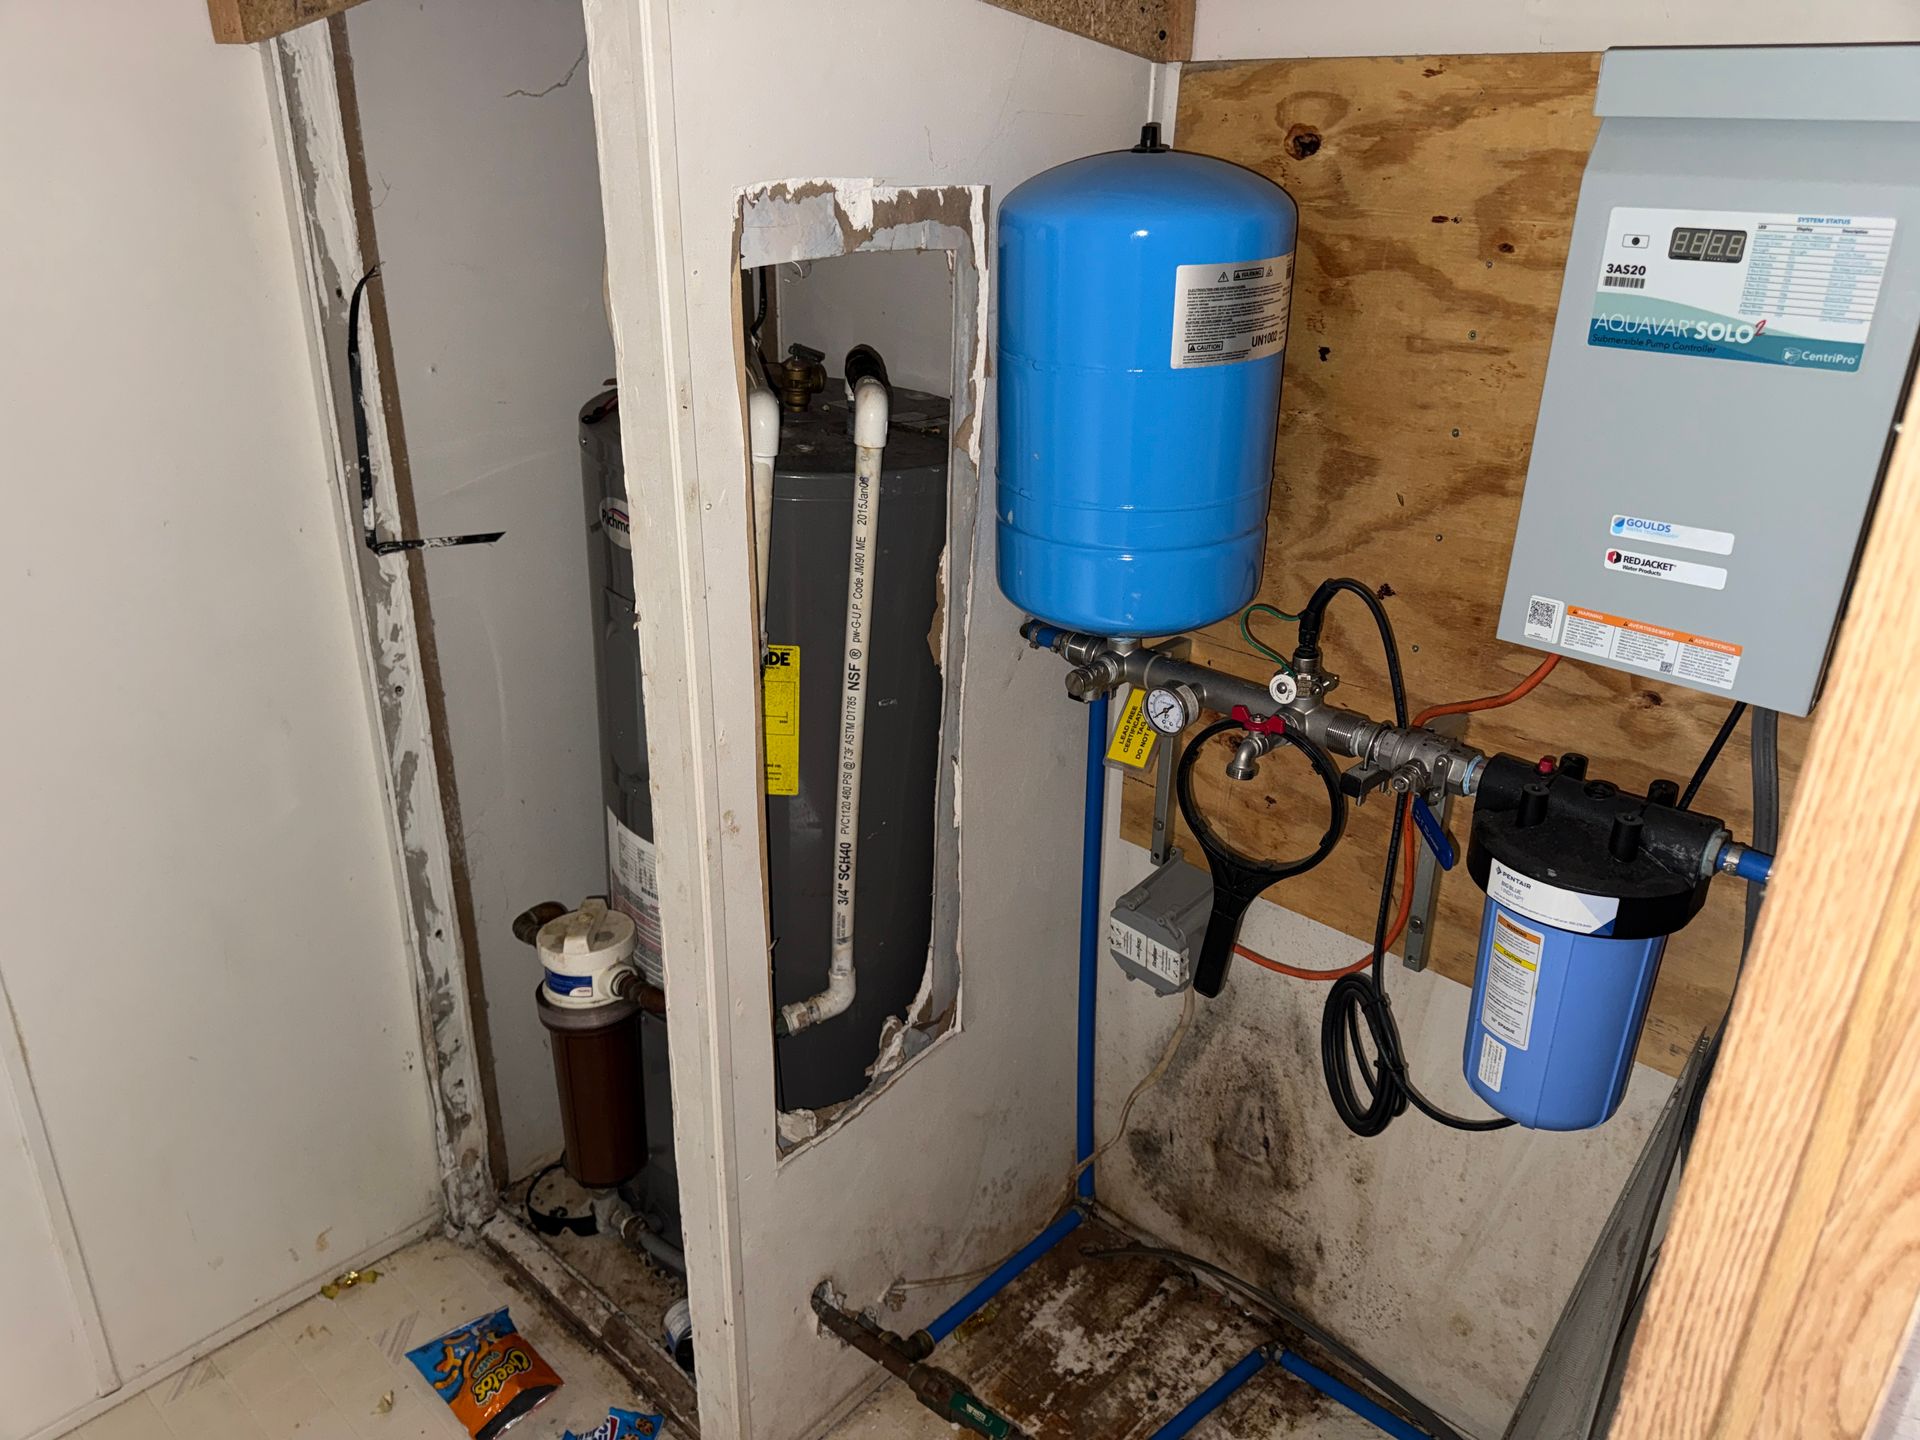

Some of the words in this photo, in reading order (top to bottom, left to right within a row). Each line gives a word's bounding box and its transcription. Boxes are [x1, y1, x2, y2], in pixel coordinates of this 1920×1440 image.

[1797, 216, 1824, 224] SYSTEM
[1825, 217, 1851, 225] STATUS
[1606, 263, 1646, 276] 3AS20
[1594, 312, 1688, 338] AQUAVAR
[1251, 331, 1278, 348] UN1002
[1592, 333, 1644, 346] Submersible
[1645, 339, 1670, 351] Pump
[1672, 341, 1717, 354] Controller
[1801, 351, 1856, 365] CentriPro
[602, 509, 630, 534] Richmo
[1626, 518, 1671, 533] GOULDS
[855, 535, 866, 551] ME
[854, 553, 865, 576] JM90
[1622, 564, 1637, 572] Water
[1638, 566, 1661, 577] Products
[853, 577, 864, 600] Code
[1577, 610, 1603, 620] WARNING
[764, 651, 791, 666] IDE
[848, 662, 861, 691] NSF
[846, 696, 857, 721] D1785
[844, 722, 855, 746] ASTM
[1119, 725, 1129, 744] LEAD
[1127, 706, 1137, 724] FREE
[1123, 706, 1143, 753] CERTIFICATI
[1135, 748, 1143, 759] DO
[1141, 733, 1149, 748] NOT
[842, 771, 853, 786] PSI
[842, 786, 852, 800] 480
[840, 801, 851, 835] PVC1120
[838, 842, 852, 881] SCH40
[1502, 870, 1532, 890] PENTAIR
[837, 883, 850, 906] 3/4"
[1503, 949, 1522, 965] CAUTION
[473, 1348, 531, 1402] Cheetos
